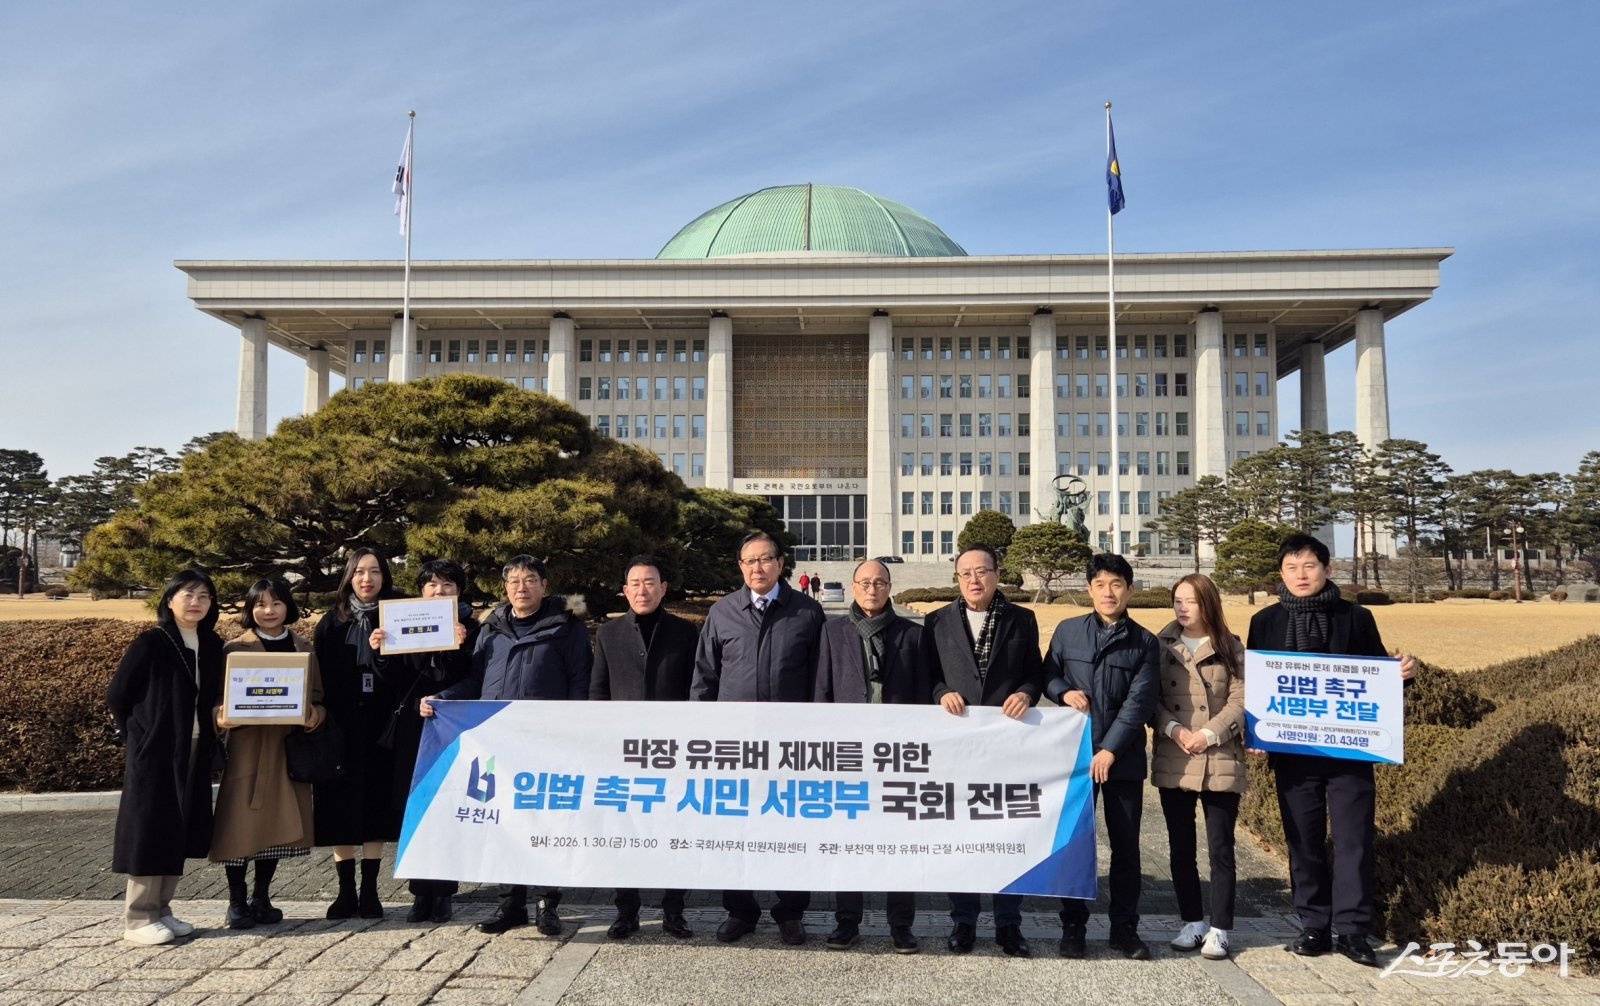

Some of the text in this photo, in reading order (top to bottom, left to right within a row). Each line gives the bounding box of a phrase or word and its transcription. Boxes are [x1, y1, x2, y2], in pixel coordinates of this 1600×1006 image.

[837, 482, 859, 490] 나온다
[1265, 660, 1380, 675] 막장 유튜버 문제 해결을 위한
[1277, 674, 1367, 699] 입법 촉구
[1266, 695, 1380, 722] 서명부 전달
[1276, 730, 1322, 743] 서명인원:
[622, 738, 932, 774] 막장 유튜버 제재를 위한
[513, 771, 1043, 821] 입법 촉구 시민 서명부 국회 전달
[455, 806, 500, 825] 부천시
[530, 836, 551, 848] 일시:
[553, 837, 581, 848] 2026.
[583, 837, 590, 848] 1.
[629, 838, 658, 849] 15:00
[669, 838, 807, 854] 장소: 국회사무처 민원지원센터
[818, 843, 1026, 855] 주관: 부천역 막장 유튜버 근절 시민대책위원회
